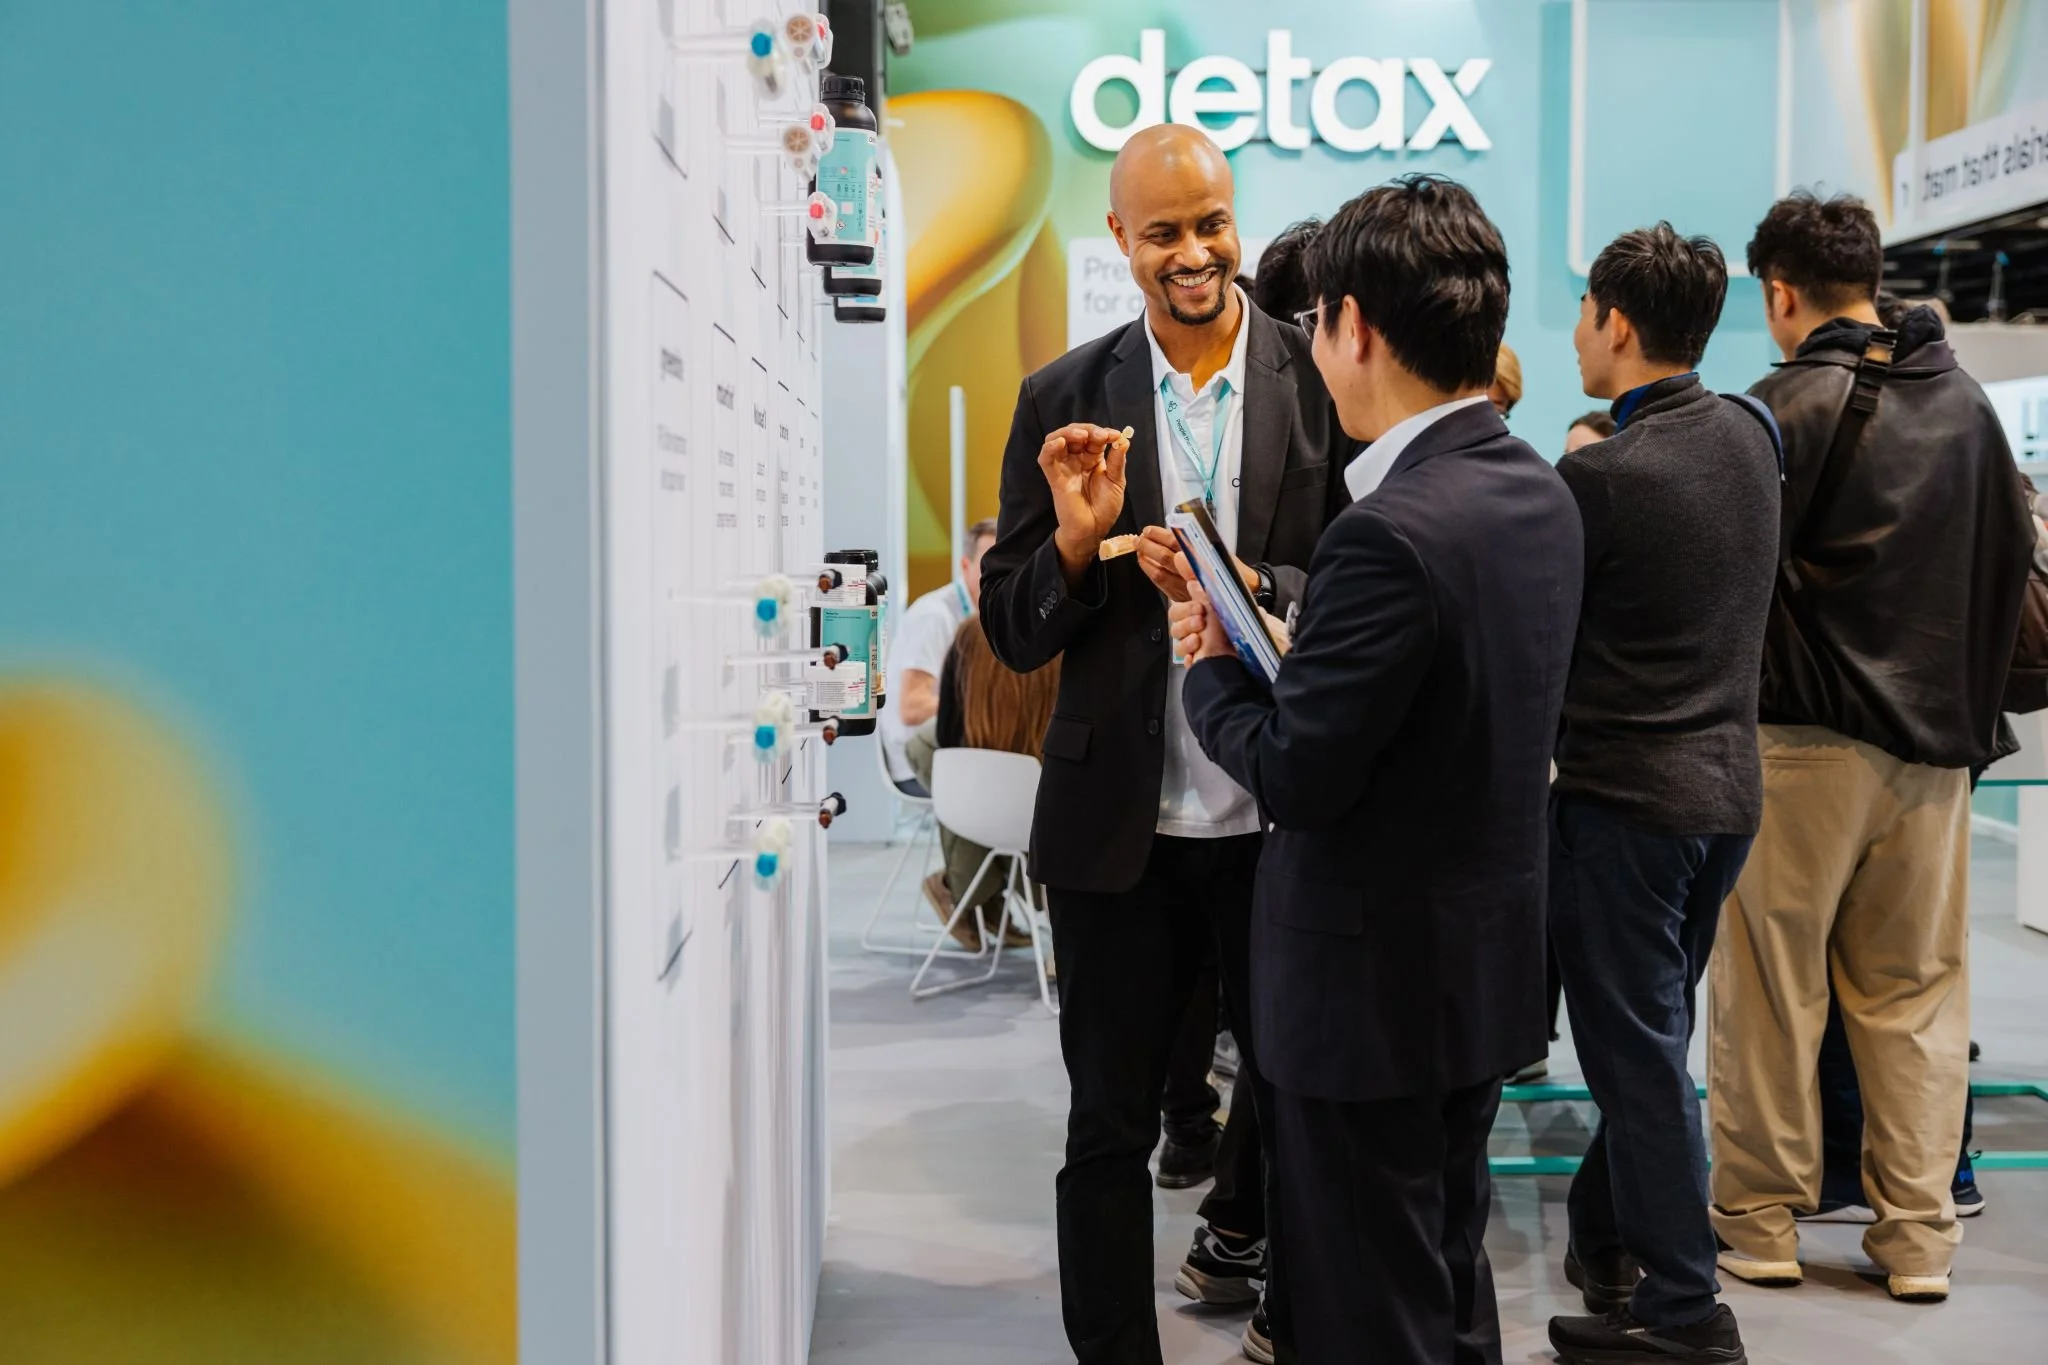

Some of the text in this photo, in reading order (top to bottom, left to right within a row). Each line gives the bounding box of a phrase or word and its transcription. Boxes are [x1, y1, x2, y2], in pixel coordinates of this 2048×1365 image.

[1070, 29, 1492, 152] detax
[1083, 256, 1130, 281] Pre
[1083, 288, 1120, 314] for
